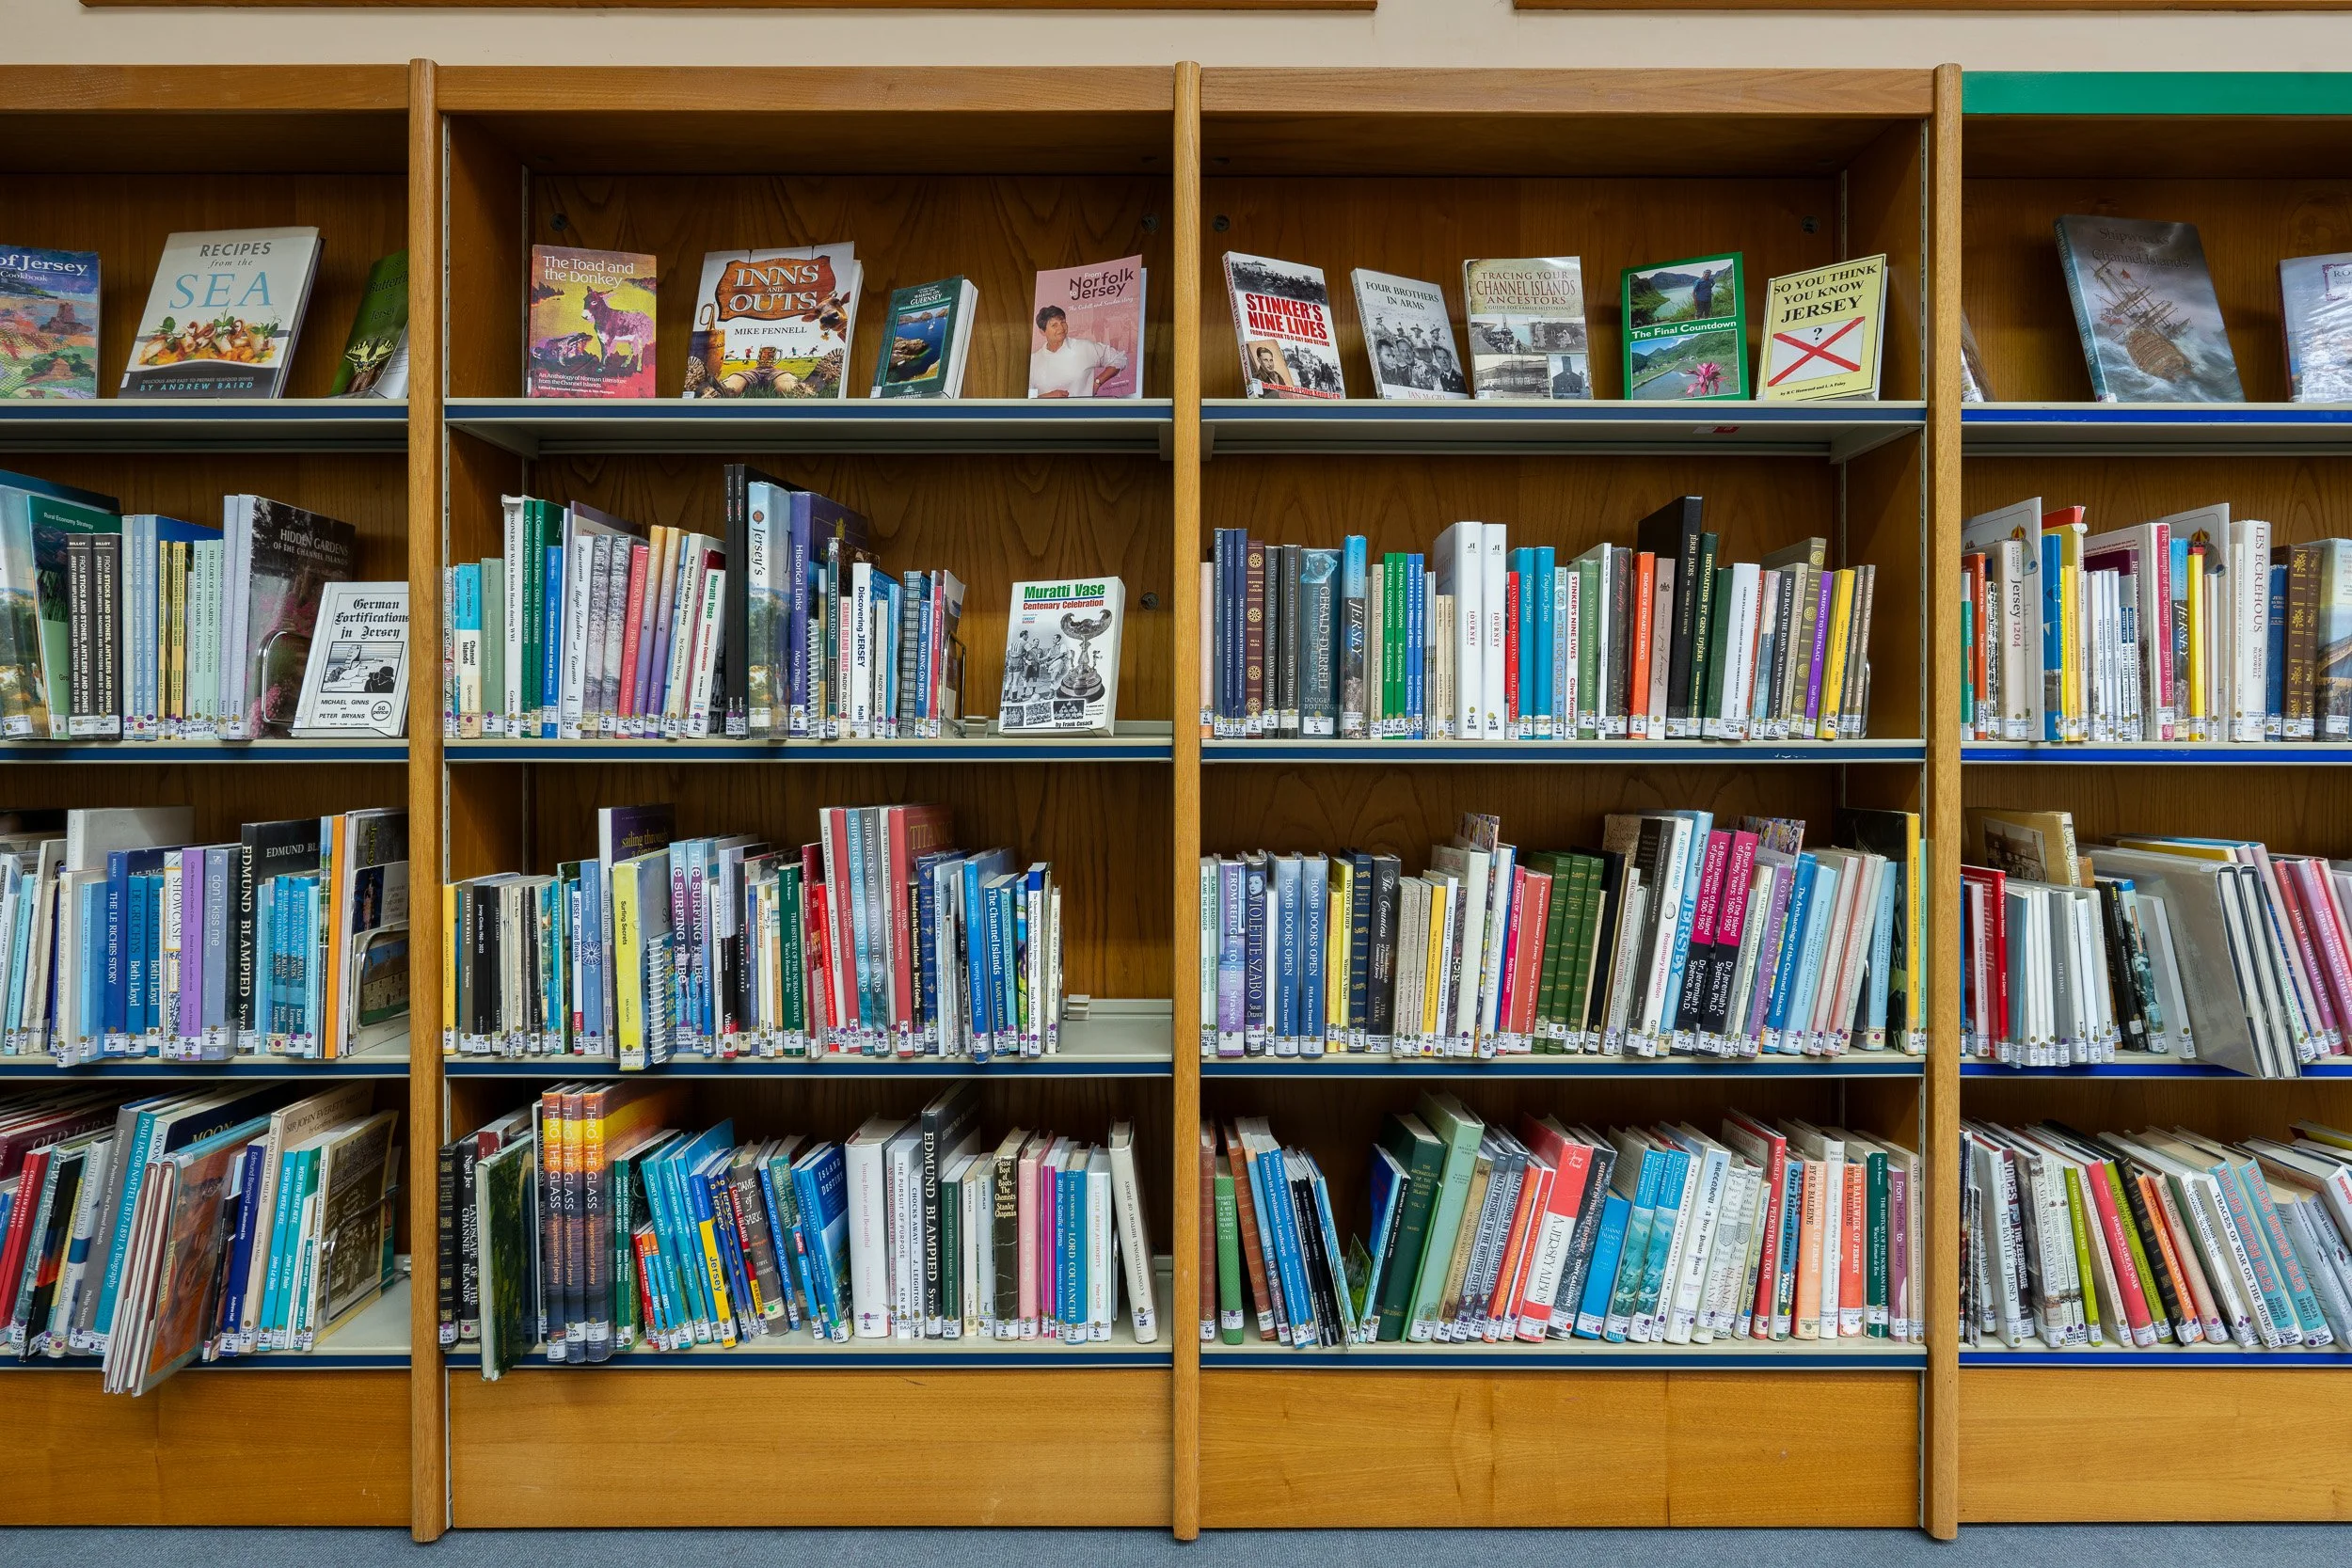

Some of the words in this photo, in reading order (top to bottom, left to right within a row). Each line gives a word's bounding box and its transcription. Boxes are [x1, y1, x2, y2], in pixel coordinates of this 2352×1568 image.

[199, 242, 271, 258] RECIPES
[2093, 248, 2142, 264] Channel
[2146, 253, 2190, 268] Islands
[1, 270, 48, 282] Cookbook
[19, 254, 88, 276] Jersey
[209, 259, 234, 268] from
[237, 259, 253, 267] the
[543, 255, 568, 270] The
[570, 258, 605, 273] Toad
[609, 261, 634, 275] and
[734, 264, 819, 287] INNS
[1084, 270, 1103, 278] From
[1481, 271, 1534, 280] TRACING
[1536, 270, 1568, 280] YOUR
[169, 271, 273, 309] SEA
[544, 268, 568, 281] the
[570, 270, 623, 289] Donkey
[1070, 268, 1135, 291] Norfolk
[1476, 280, 1529, 295] CHANNEL
[1531, 279, 1576, 295] ISLANDS
[1774, 283, 1791, 294] SO
[1796, 276, 1825, 290] YOU
[1830, 264, 1877, 282] THINK
[728, 291, 818, 313] OUTS
[910, 293, 943, 306] GUERNSEY
[1071, 282, 1126, 302] Jersey
[1365, 281, 1391, 294] FOUR
[1392, 286, 1439, 303] BROTHERS
[1387, 295, 1397, 306] IN
[1399, 298, 1425, 310] ARMS
[1486, 296, 1566, 305] ANCESTORS
[1784, 292, 1814, 304] YOU
[1818, 280, 1865, 297] KNOW
[1246, 293, 1323, 322] STINKER'S
[1781, 294, 1863, 324] JERSEY
[734, 326, 760, 336] MIKE
[761, 325, 807, 336] FENNELL
[1248, 310, 1283, 333] NINE
[1289, 317, 1327, 340] LIVES
[1631, 329, 1652, 340] The
[1654, 326, 1677, 337] Final
[1679, 320, 1737, 334] Countdown
[160, 382, 211, 391] ANDREW
[216, 381, 253, 390] BAIRD
[44, 512, 55, 520] Rural
[56, 515, 75, 527] Economy
[77, 520, 93, 530] Strategy
[280, 529, 311, 546] HIDDEN
[313, 537, 349, 556] GARDENS
[2256, 527, 2265, 549] LES
[283, 544, 294, 553] THE
[296, 547, 324, 562] CHANNEL
[326, 554, 348, 565] ISLANDS
[753, 528, 766, 576] Jersey's
[353, 598, 399, 610] German
[1023, 602, 1060, 610] Centenary
[1062, 599, 1104, 610] Celebration
[1024, 585, 1071, 599] Muratti
[1075, 584, 1105, 596] Vase
[2010, 579, 2021, 617] Jersey
[1319, 586, 1329, 633] GERALD
[1348, 599, 1363, 658] JERSEY
[2012, 622, 2021, 647] 1204
[2175, 602, 2188, 660] JERSEY
[1318, 638, 1328, 692] DURRELL
[212, 875, 223, 901] don't
[242, 846, 252, 913] EDMUND
[988, 888, 996, 901] The
[1285, 879, 1294, 909] BOMB
[1311, 879, 1319, 909] BOMB
[110, 912, 117, 922] LE
[173, 878, 182, 942] SHOWCASE
[212, 904, 223, 926] kiss
[989, 904, 998, 942] Channel
[212, 929, 219, 947] me
[1248, 895, 1263, 955] VIOLETTE
[1671, 895, 1693, 978] JERSEY
[240, 919, 251, 997] BLAMPIED
[991, 944, 1000, 975] Islands
[1661, 932, 1671, 961] Rosemary
[108, 958, 117, 985] STORY
[131, 960, 140, 979] Beth
[1284, 950, 1293, 976] OPEN
[1310, 950, 1318, 976] OPEN
[1452, 957, 1461, 982] RICH
[1248, 958, 1262, 1000] SZABO
[1654, 963, 1666, 999] Hampton
[1693, 970, 1704, 1004] Jeremiah
[129, 982, 140, 1006] Lloyd
[239, 1004, 247, 1031] Syvre
[153, 1133, 163, 1161] MOON
[549, 1142, 560, 1166] THE
[586, 1143, 596, 1167] THE
[925, 1132, 936, 1198] EDMUND
[549, 1171, 561, 1209] GLASS
[586, 1171, 597, 1209] GLASS
[737, 1179, 755, 1192] DAME
[2005, 1160, 2018, 1201] VOICES
[774, 1166, 786, 1200] BARBARA
[782, 1202, 791, 1228] STONEY
[732, 1190, 742, 1217] CHANNEL
[739, 1219, 749, 1243] ISLANDS
[743, 1212, 763, 1225] SARK
[1787, 1193, 1797, 1229] Island
[1271, 1193, 1280, 1225] Prehistoric
[1277, 1226, 1286, 1258] Landscape
[926, 1205, 937, 1281] BLAMPIED
[1068, 1233, 1076, 1259] LORD
[1783, 1232, 1793, 1266] Home
[2215, 1193, 2232, 1228] TRACES
[2230, 1230, 2239, 1243] OF
[2235, 1245, 2248, 1266] WAR
[2244, 1268, 2252, 1281] ON
[2249, 1283, 2261, 1302] THE
[2236, 1215, 2262, 1259] BRITISH
[2253, 1261, 2275, 1293] ISLES
[709, 1257, 723, 1292] Jersey
[1068, 1262, 1076, 1320] COUTANCHE
[1780, 1272, 1790, 1304] Wood
[2266, 1298, 2280, 1321] BARRETT
[2274, 1297, 2287, 1319] DUNCAN
